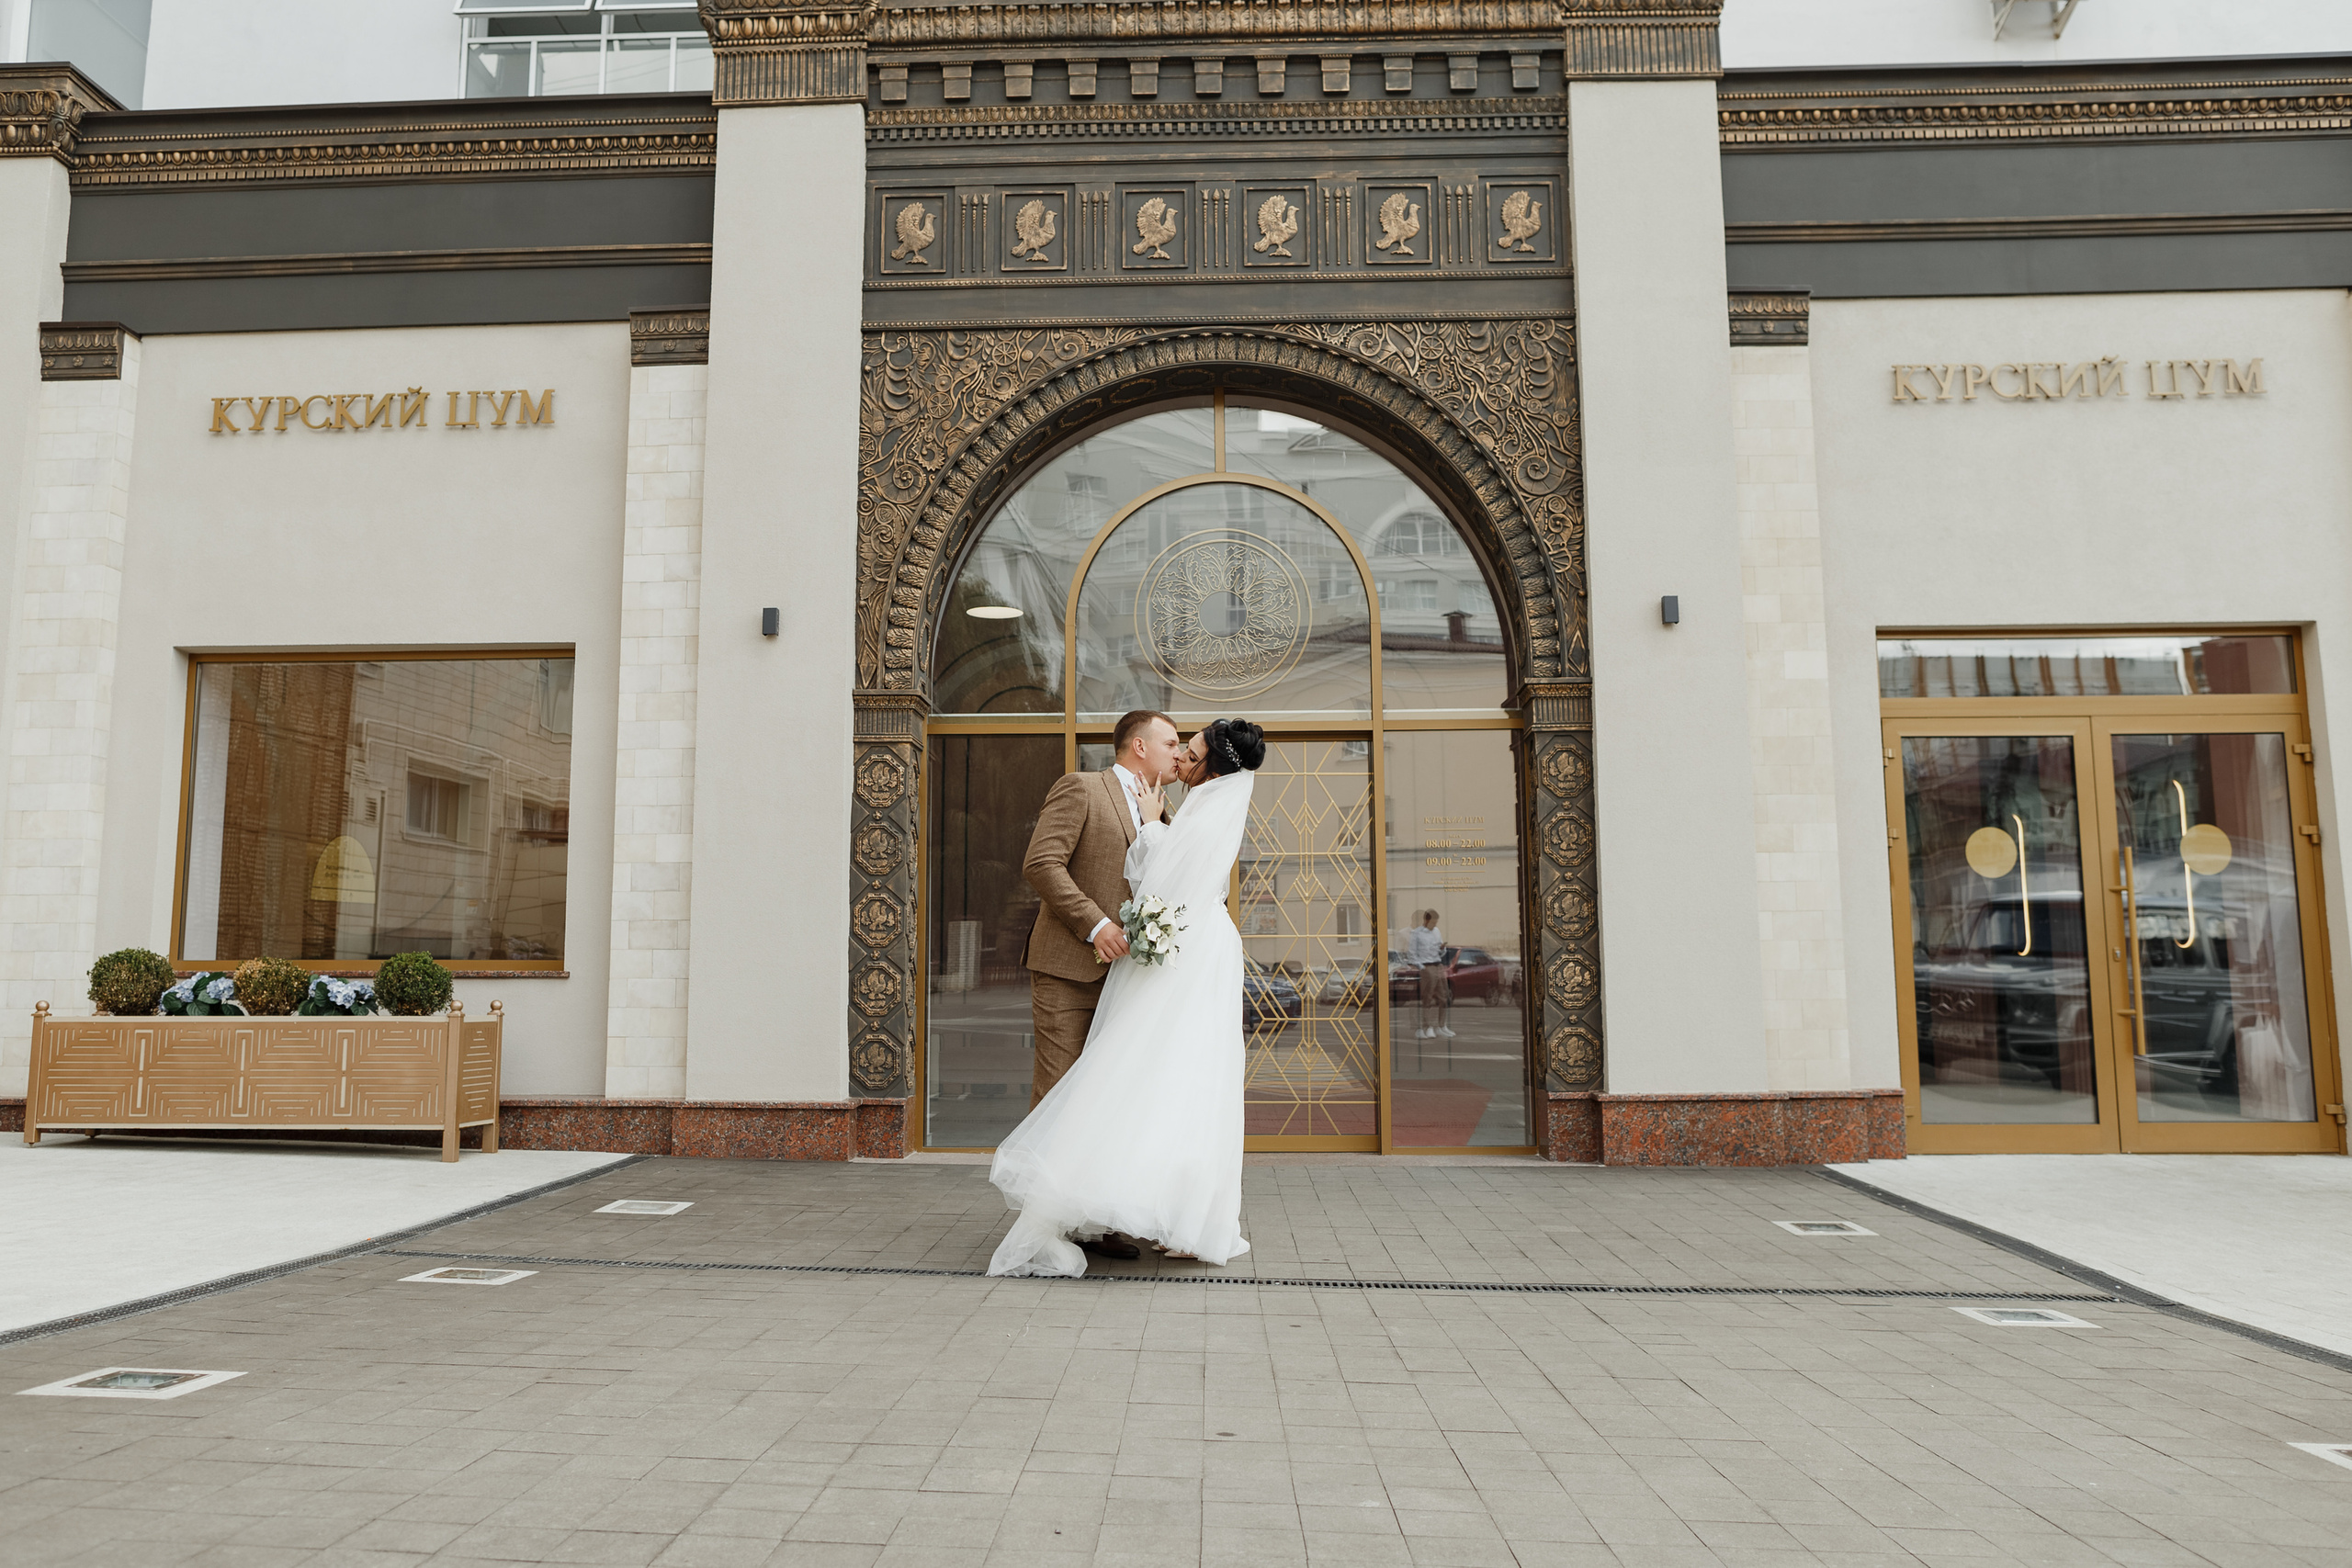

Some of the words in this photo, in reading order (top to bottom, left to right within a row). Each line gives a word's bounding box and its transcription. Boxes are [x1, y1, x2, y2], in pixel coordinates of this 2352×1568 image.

[1891, 354, 2130, 400] КУРСКИЙ
[2145, 357, 2268, 400] ЦУМ
[209, 385, 430, 432] КУРСКИЙ
[445, 389, 555, 429] ЦУМ
[1426, 839, 1452, 848] 08.00
[1460, 839, 1486, 848] 22.00
[1426, 857, 1452, 866] 09.00
[1461, 857, 1487, 866] 22.00
